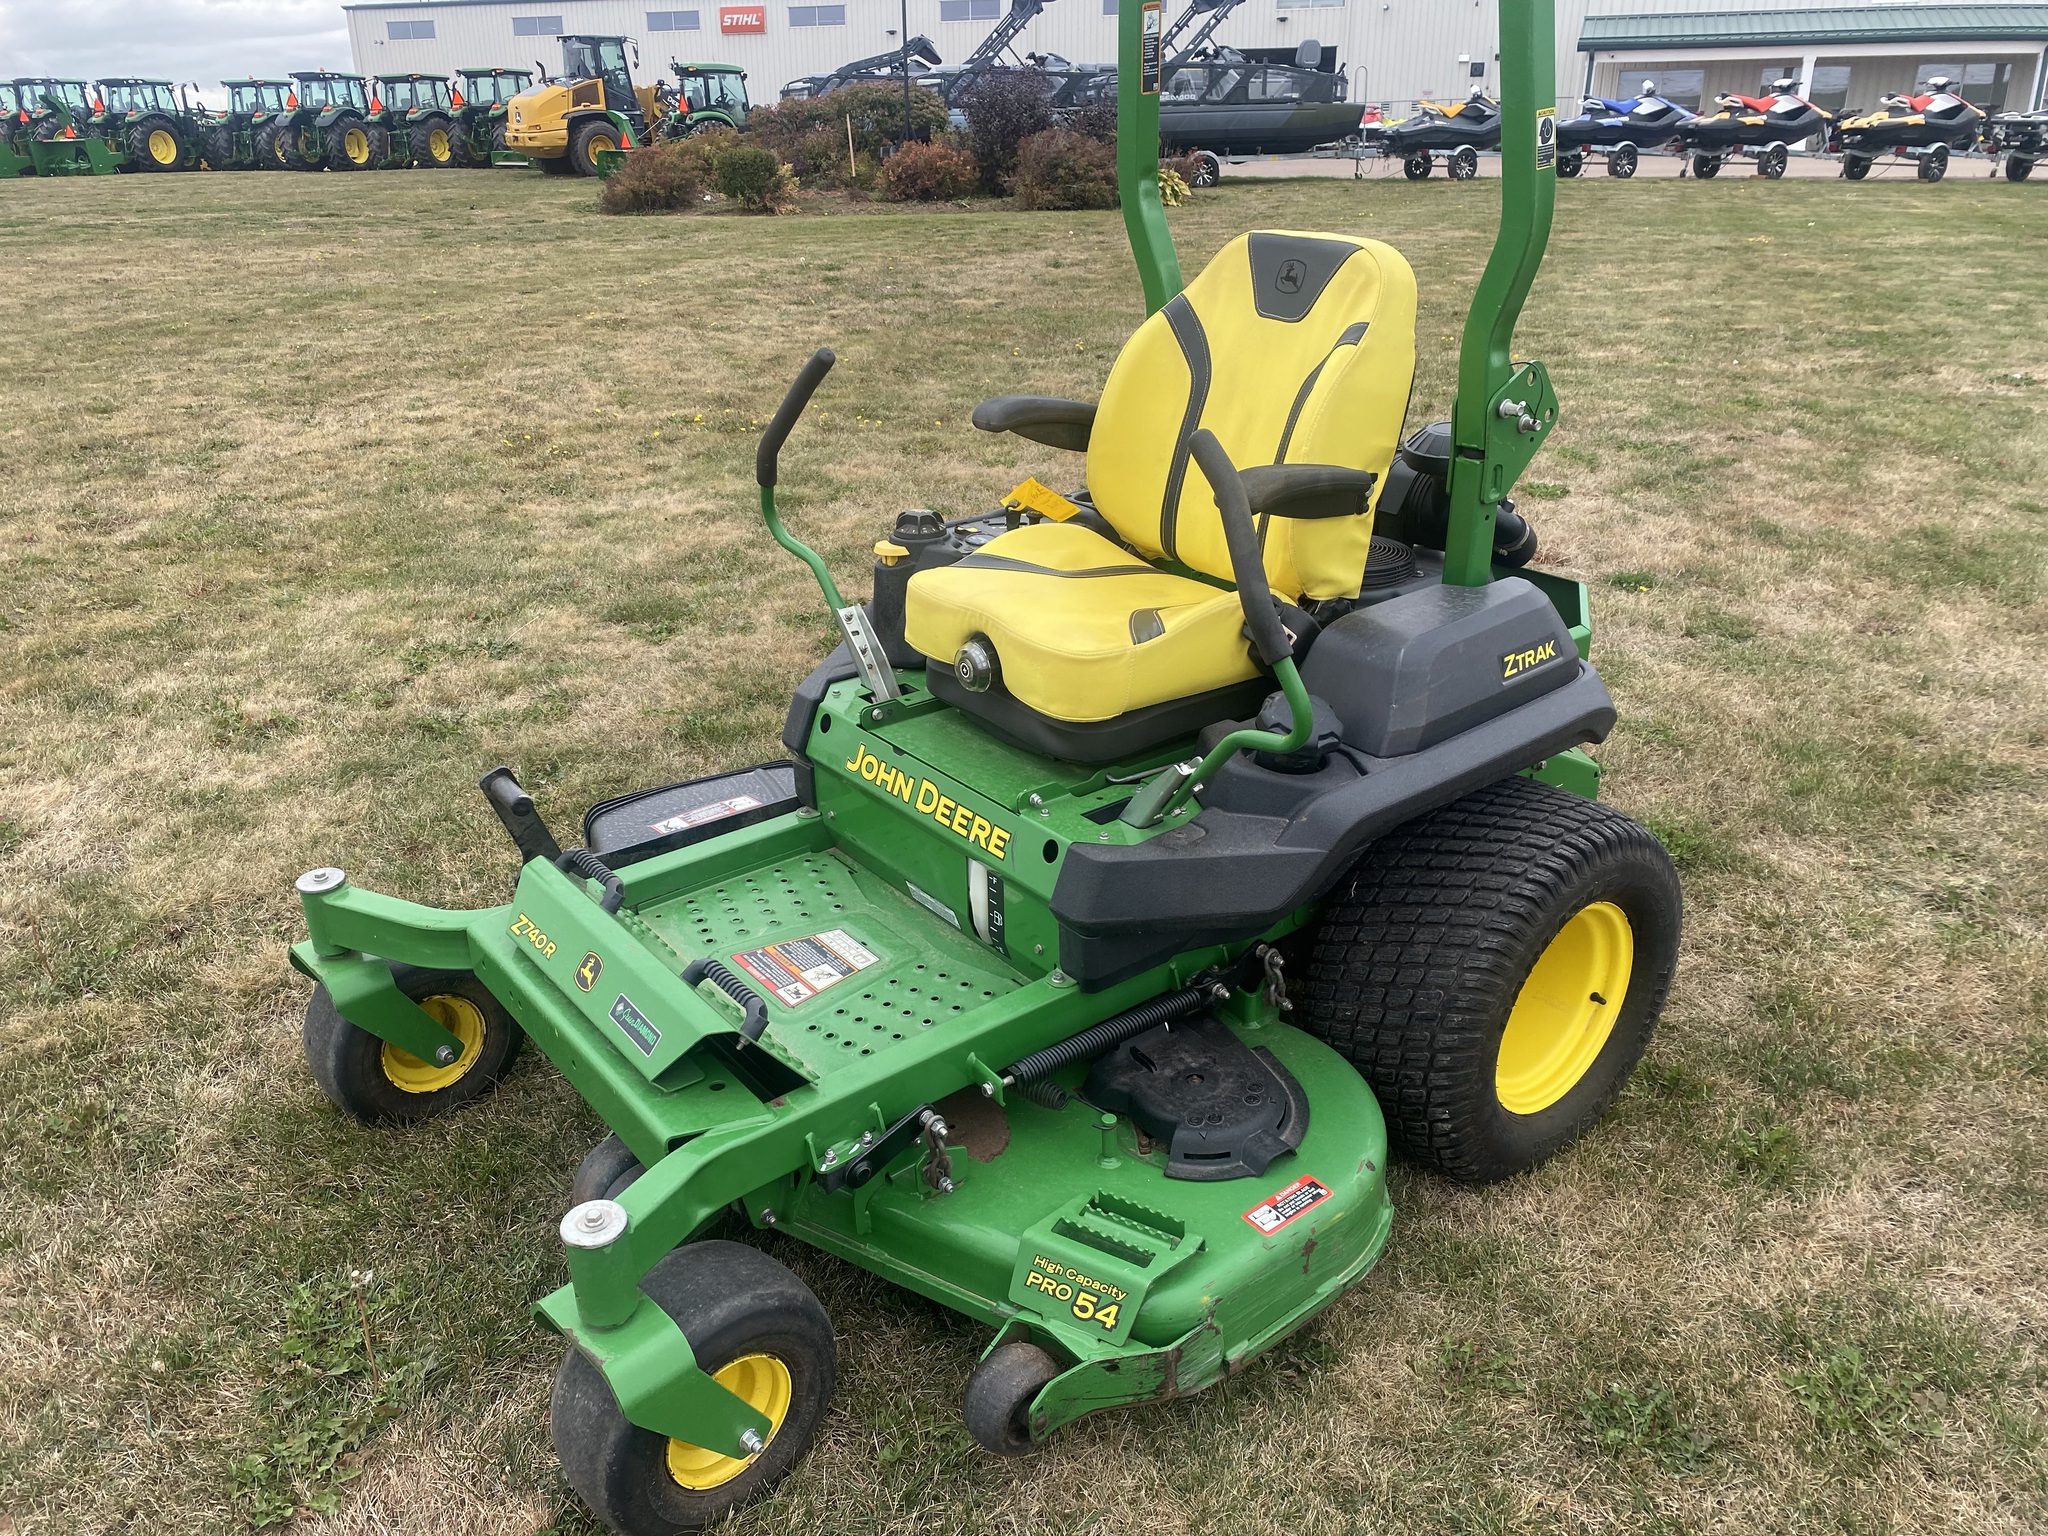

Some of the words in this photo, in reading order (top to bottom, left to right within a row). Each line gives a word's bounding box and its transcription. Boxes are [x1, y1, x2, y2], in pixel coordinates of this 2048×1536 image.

[722, 13, 761, 26] STIHL
[1503, 639, 1557, 678] ZTRAK
[845, 742, 915, 804] JOHN
[914, 778, 1011, 860] DEERE
[1278, 1181, 1301, 1197] DANGER
[1033, 1254, 1064, 1276] High
[1065, 1267, 1129, 1302] Capacity
[1025, 1271, 1073, 1302] PRO
[1072, 1289, 1121, 1332] 54
